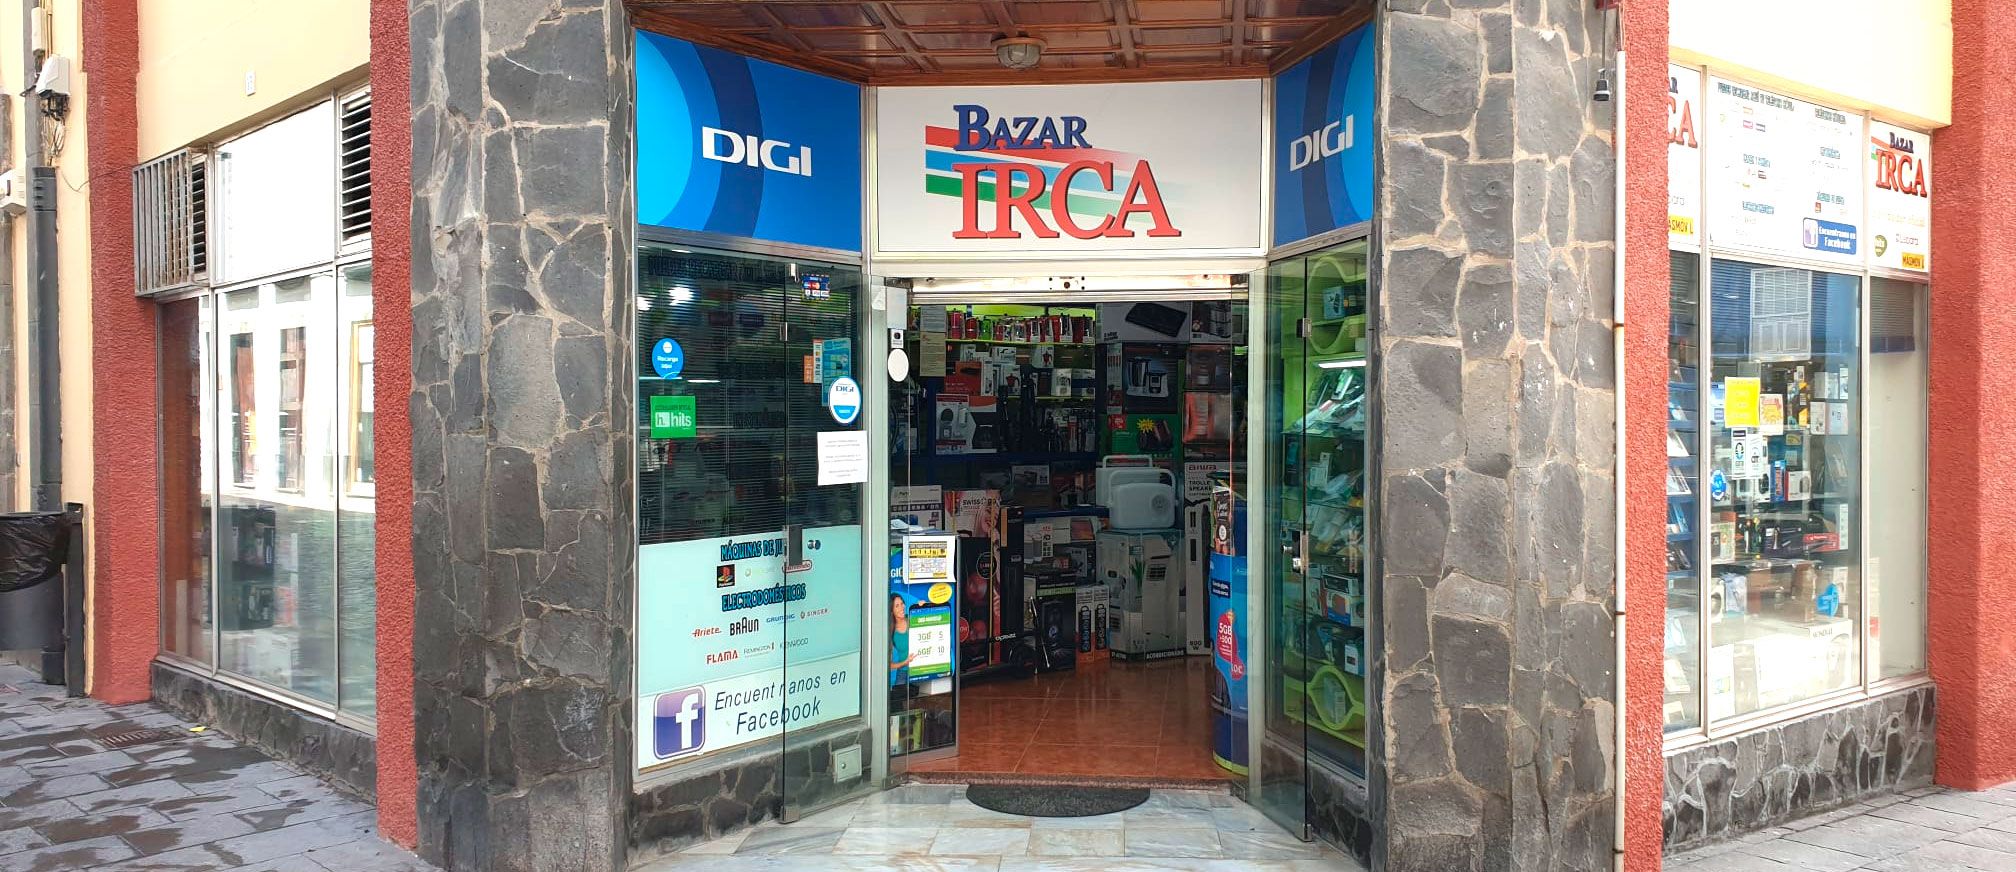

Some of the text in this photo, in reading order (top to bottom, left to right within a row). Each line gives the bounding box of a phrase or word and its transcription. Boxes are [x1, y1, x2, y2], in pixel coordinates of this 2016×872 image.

[953, 104, 1093, 152] BAZAR
[1289, 114, 1355, 172] DIGI
[1889, 132, 1914, 154] BAZAR
[701, 126, 813, 177] DIGI
[1875, 148, 1928, 198] IRCA
[952, 159, 1182, 240] IRCA
[671, 411, 692, 428] hits
[720, 540, 762, 562] MÁQUINAS
[763, 539, 774, 557] DE
[692, 626, 722, 638] Ariete
[729, 617, 760, 637] BRAUN
[706, 649, 739, 665] FLAMA
[830, 670, 846, 685] en
[736, 695, 822, 736] Facebook
